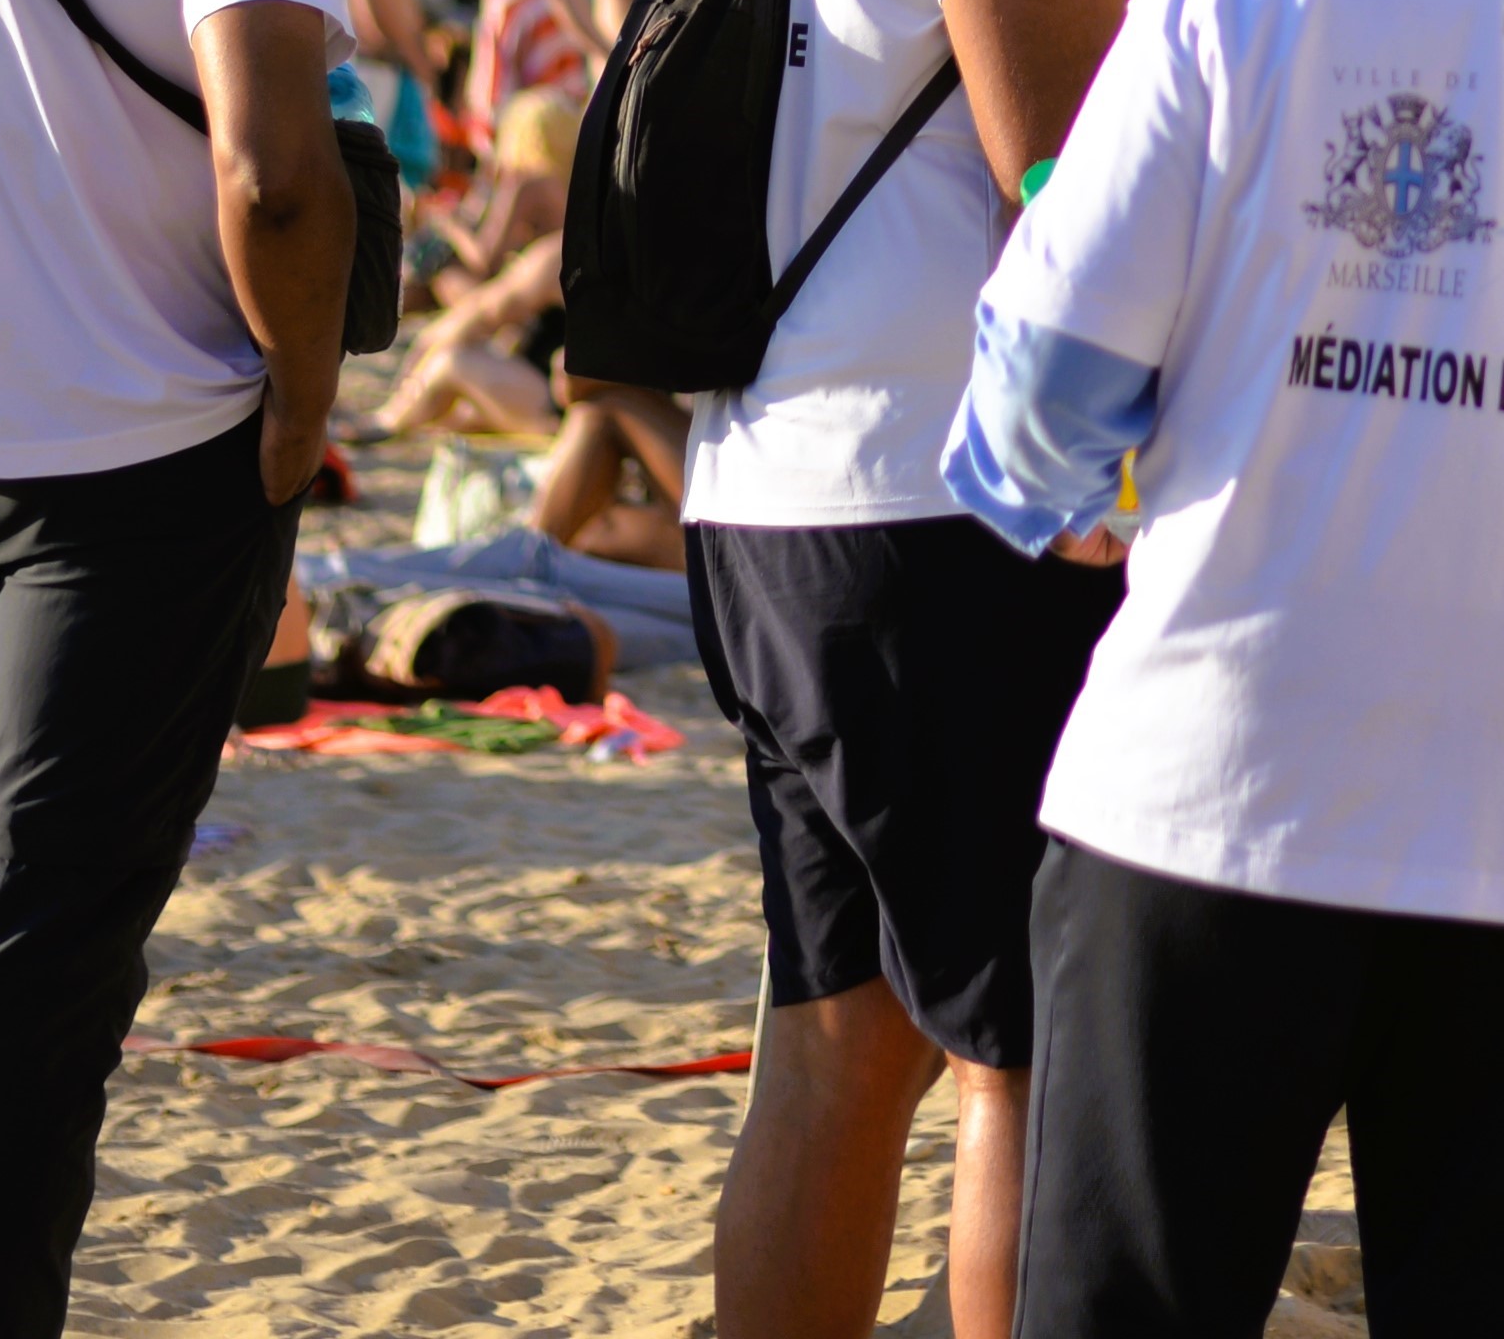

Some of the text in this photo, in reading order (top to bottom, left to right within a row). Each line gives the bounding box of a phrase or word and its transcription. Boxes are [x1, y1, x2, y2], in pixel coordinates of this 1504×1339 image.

[1333, 66, 1479, 92] VILLE DE
[1326, 260, 1467, 298] MARSEILLE
[1288, 322, 1487, 409] MÉDIATION
